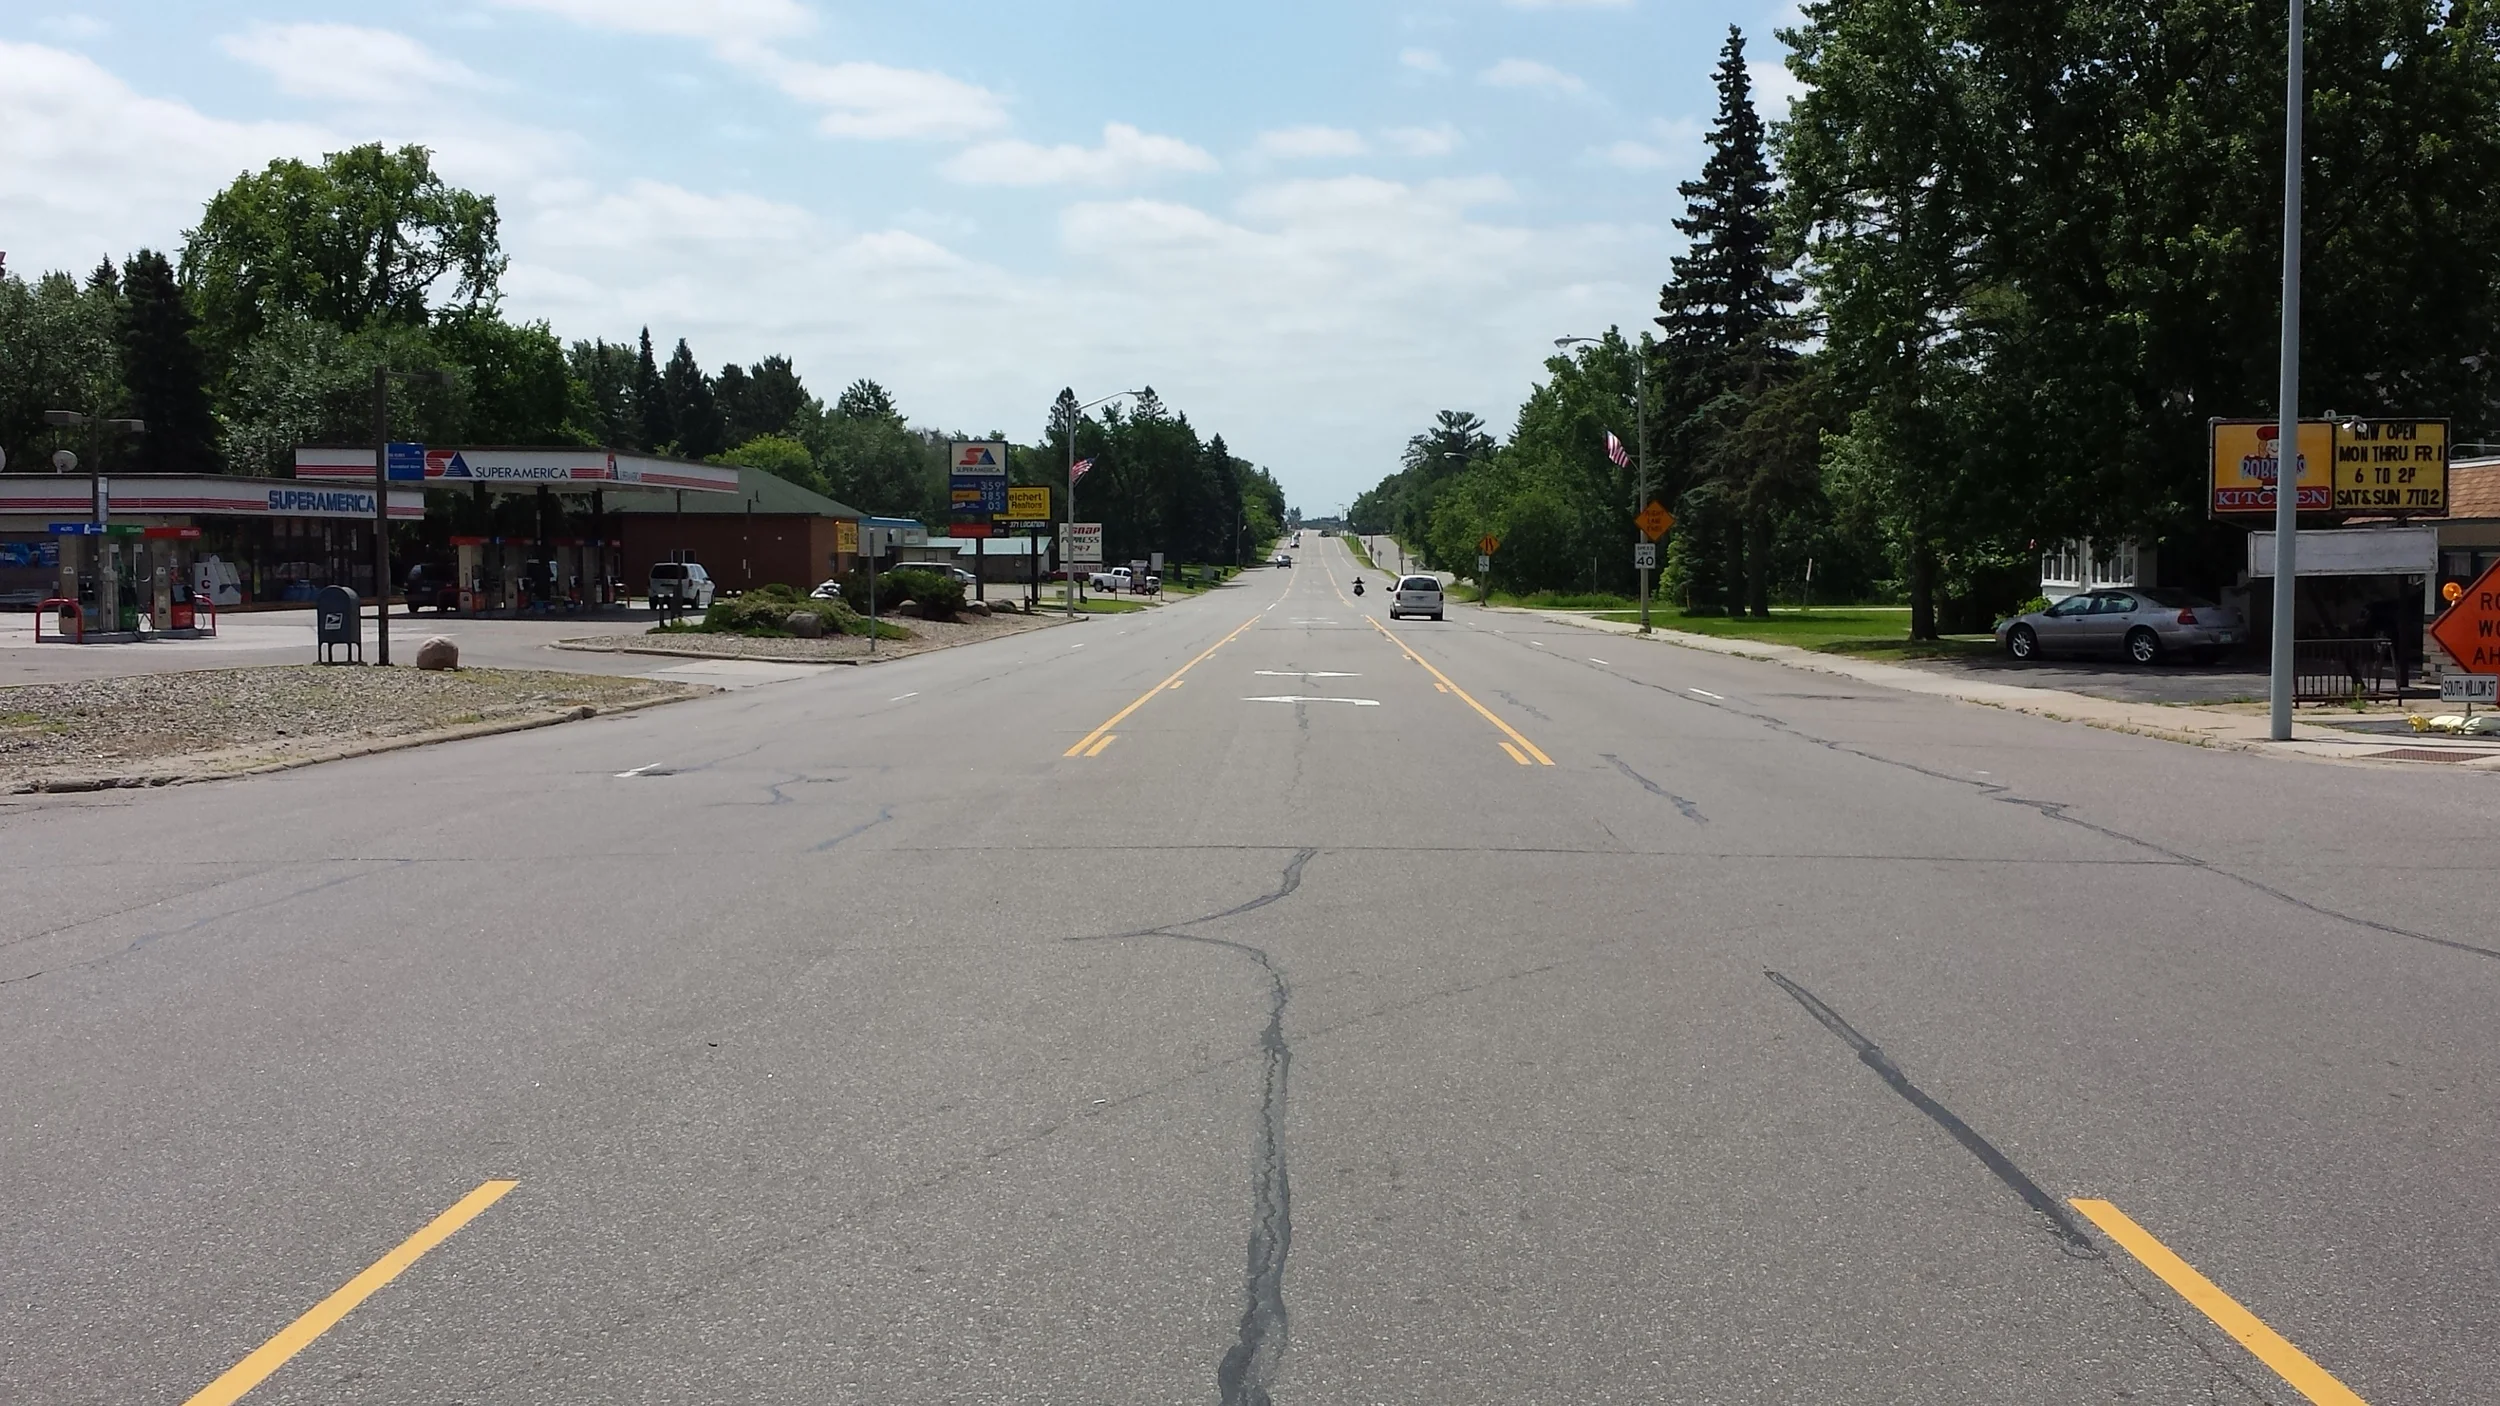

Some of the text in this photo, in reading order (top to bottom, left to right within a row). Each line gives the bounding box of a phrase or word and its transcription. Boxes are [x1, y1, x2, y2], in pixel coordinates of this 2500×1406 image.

[2355, 424, 2417, 441] NOW OPEN
[2339, 446, 2368, 462] MON
[2372, 445, 2408, 461] THRU
[475, 467, 568, 478] SUPERAMERICA
[2355, 468, 2416, 484] 6 TO 2P
[269, 489, 376, 513] SUPERAMERICA
[1009, 493, 1042, 501] eichert
[1011, 501, 1043, 509] Realtors
[2216, 490, 2328, 506] KITCEN
[1636, 556, 1654, 566] 40
[2444, 680, 2496, 697] SOUTH WILLOW ST
